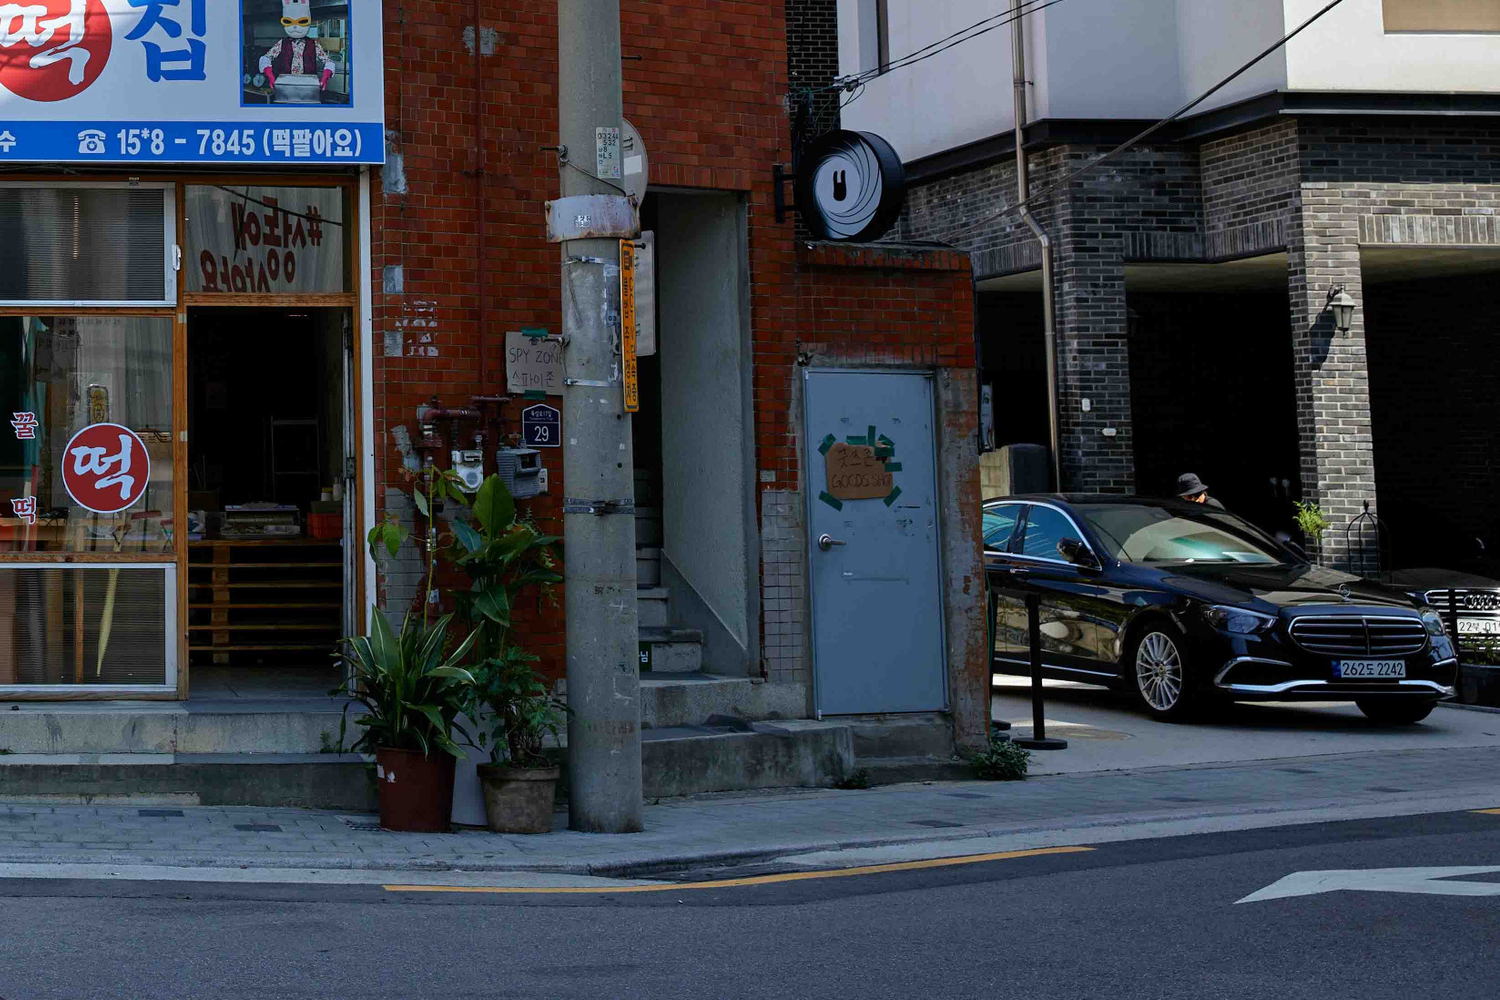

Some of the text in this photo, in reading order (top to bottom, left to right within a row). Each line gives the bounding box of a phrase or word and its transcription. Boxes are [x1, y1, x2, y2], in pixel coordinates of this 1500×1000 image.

[197, 131, 257, 156] 7845
[262, 129, 363, 158] (떡팔아요)
[509, 347, 530, 364] SPY
[534, 425, 549, 442] 29
[10, 411, 39, 525] 꿀떡
[70, 434, 135, 501] 떡
[1483, 621, 1500, 632] 01
[1342, 661, 1404, 677] 262도 2242
